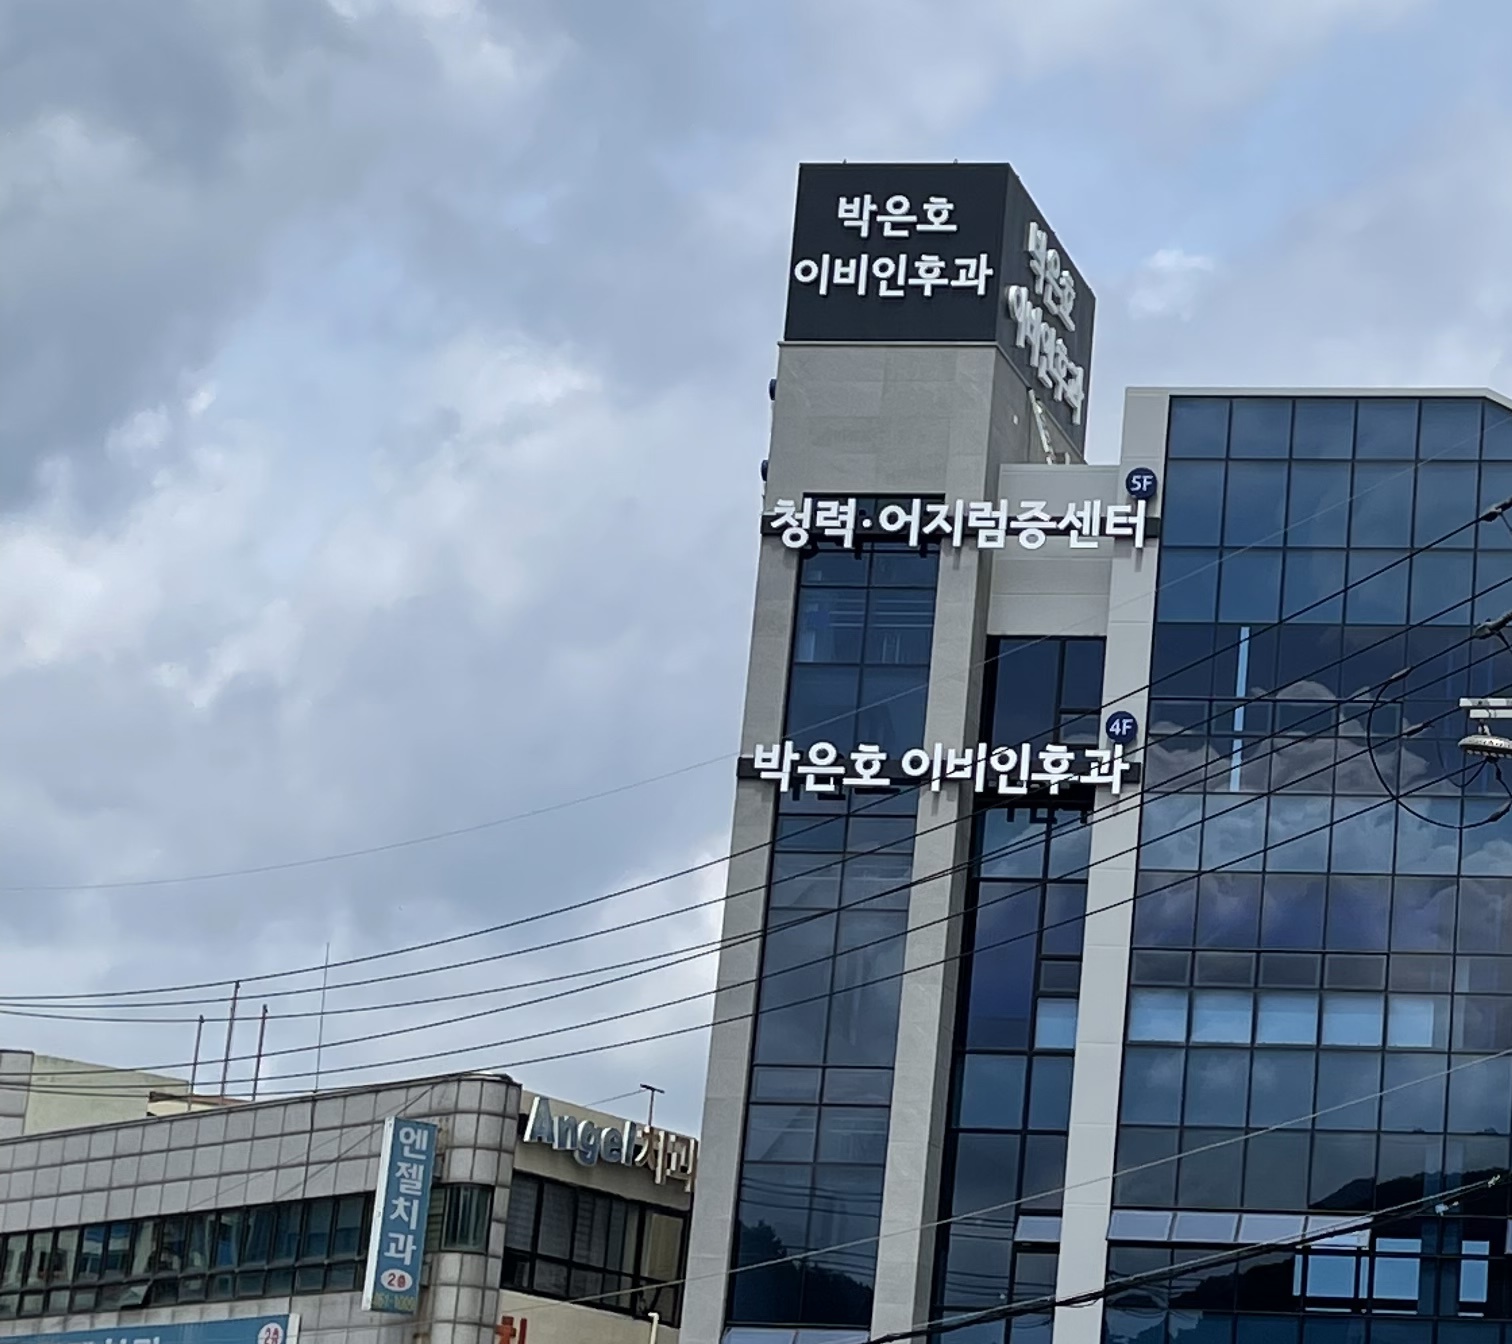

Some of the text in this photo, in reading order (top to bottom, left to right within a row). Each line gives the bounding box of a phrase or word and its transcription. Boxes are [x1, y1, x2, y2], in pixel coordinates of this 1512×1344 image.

[838, 195, 958, 237] 박은호
[794, 253, 994, 298] 이비인후과
[1130, 473, 1154, 493] 5F
[1108, 717, 1134, 736] 4F
[753, 740, 1131, 795] 박은호 이비인후과
[384, 1126, 428, 1266] 엔젤치과
